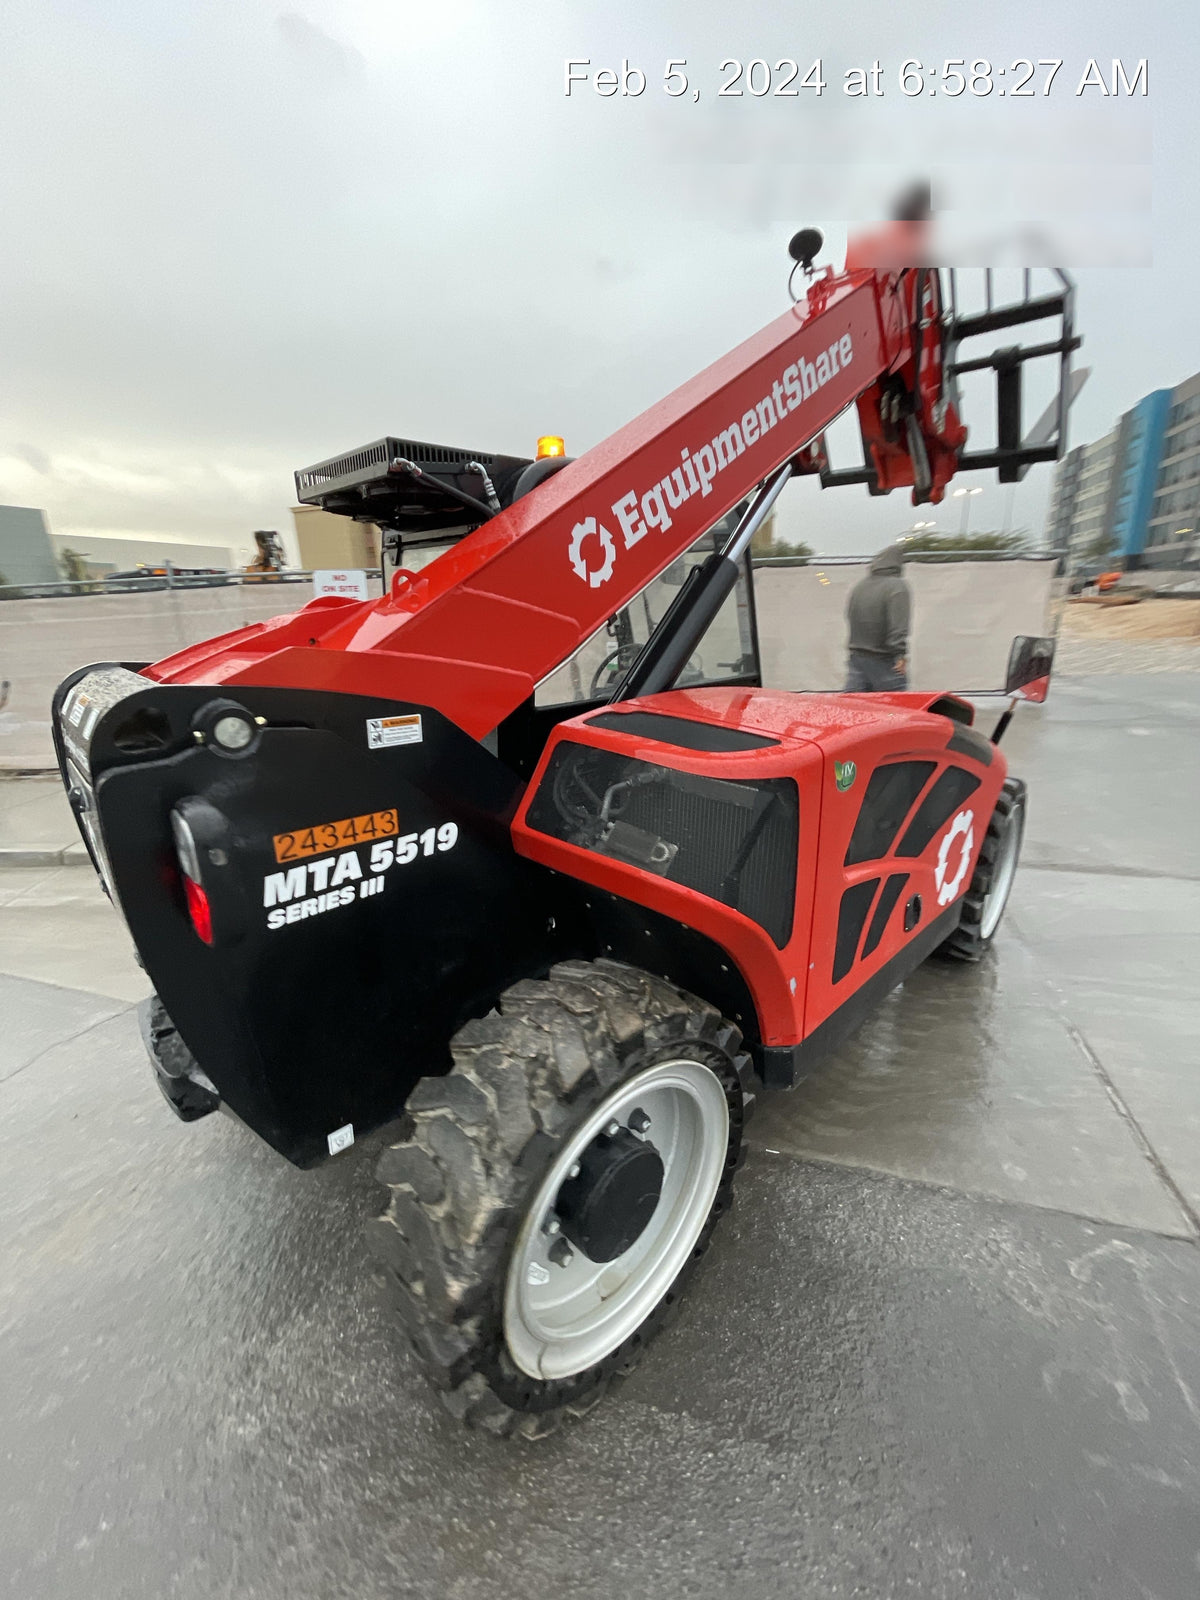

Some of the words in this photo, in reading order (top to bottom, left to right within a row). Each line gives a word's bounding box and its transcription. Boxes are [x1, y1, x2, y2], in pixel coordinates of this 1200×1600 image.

[611, 332, 854, 551] EquipmentShare
[263, 850, 363, 908] MTA
[370, 821, 459, 873] 5519
[278, 810, 397, 861] 243443
[266, 886, 356, 930] SERIES
[360, 875, 385, 899] III
